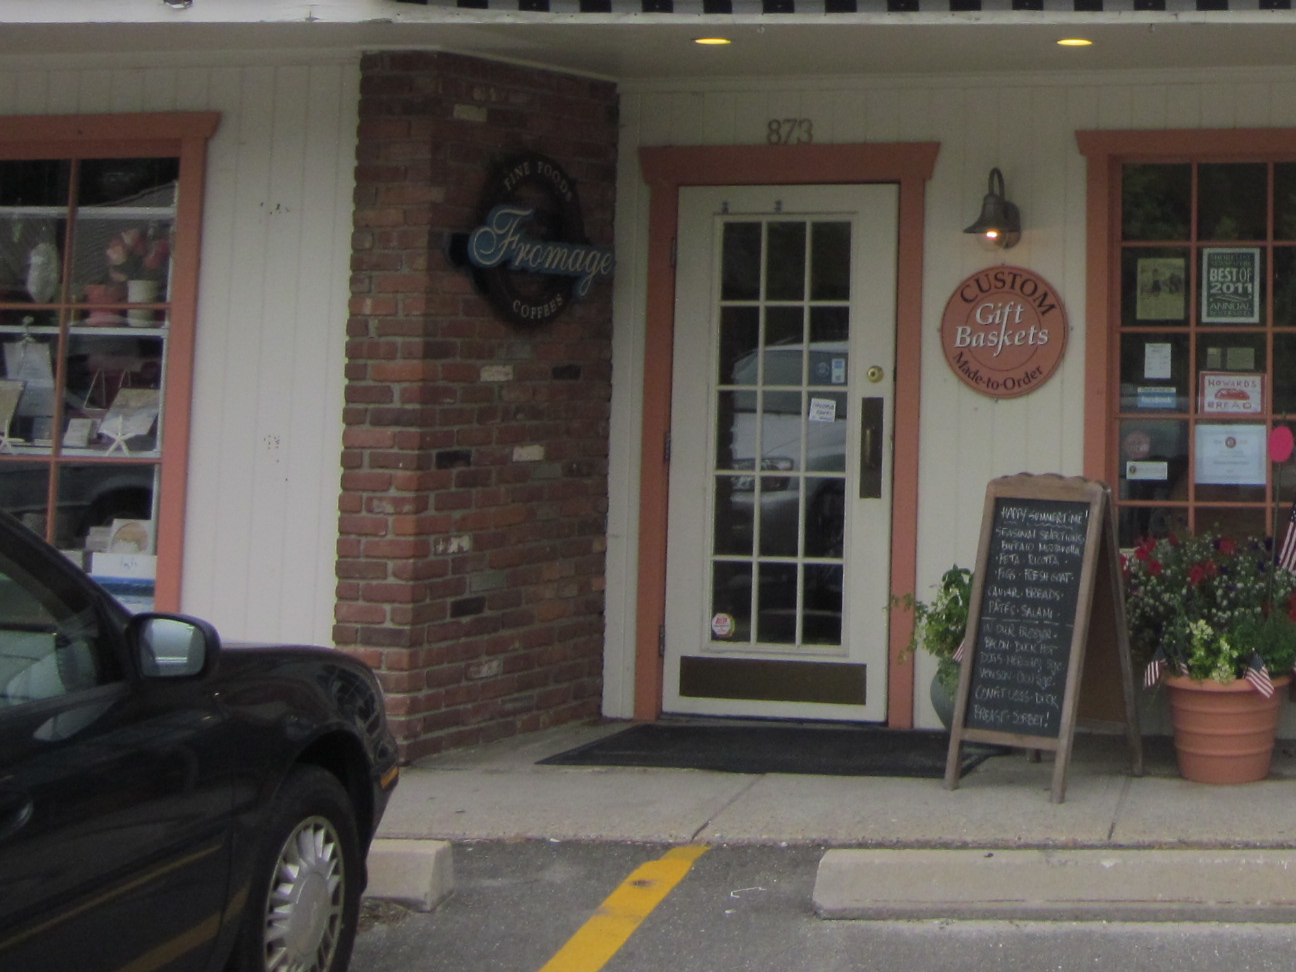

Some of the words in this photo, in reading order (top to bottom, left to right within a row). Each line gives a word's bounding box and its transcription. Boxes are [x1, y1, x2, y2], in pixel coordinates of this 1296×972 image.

[767, 118, 813, 145] 873
[504, 161, 531, 191] FINE
[537, 161, 572, 202] FOODS
[470, 208, 614, 298] Fromage
[1209, 267, 1238, 282] BEST
[1239, 268, 1253, 282] OF
[1209, 282, 1253, 294] 2011
[513, 293, 562, 319] COFFEES
[960, 271, 1056, 316] CUSTOM
[975, 301, 1024, 345] Gift
[954, 325, 1049, 352] Baskets
[953, 352, 1043, 390] Made-to-Order
[1001, 506, 1027, 523] HAPPY
